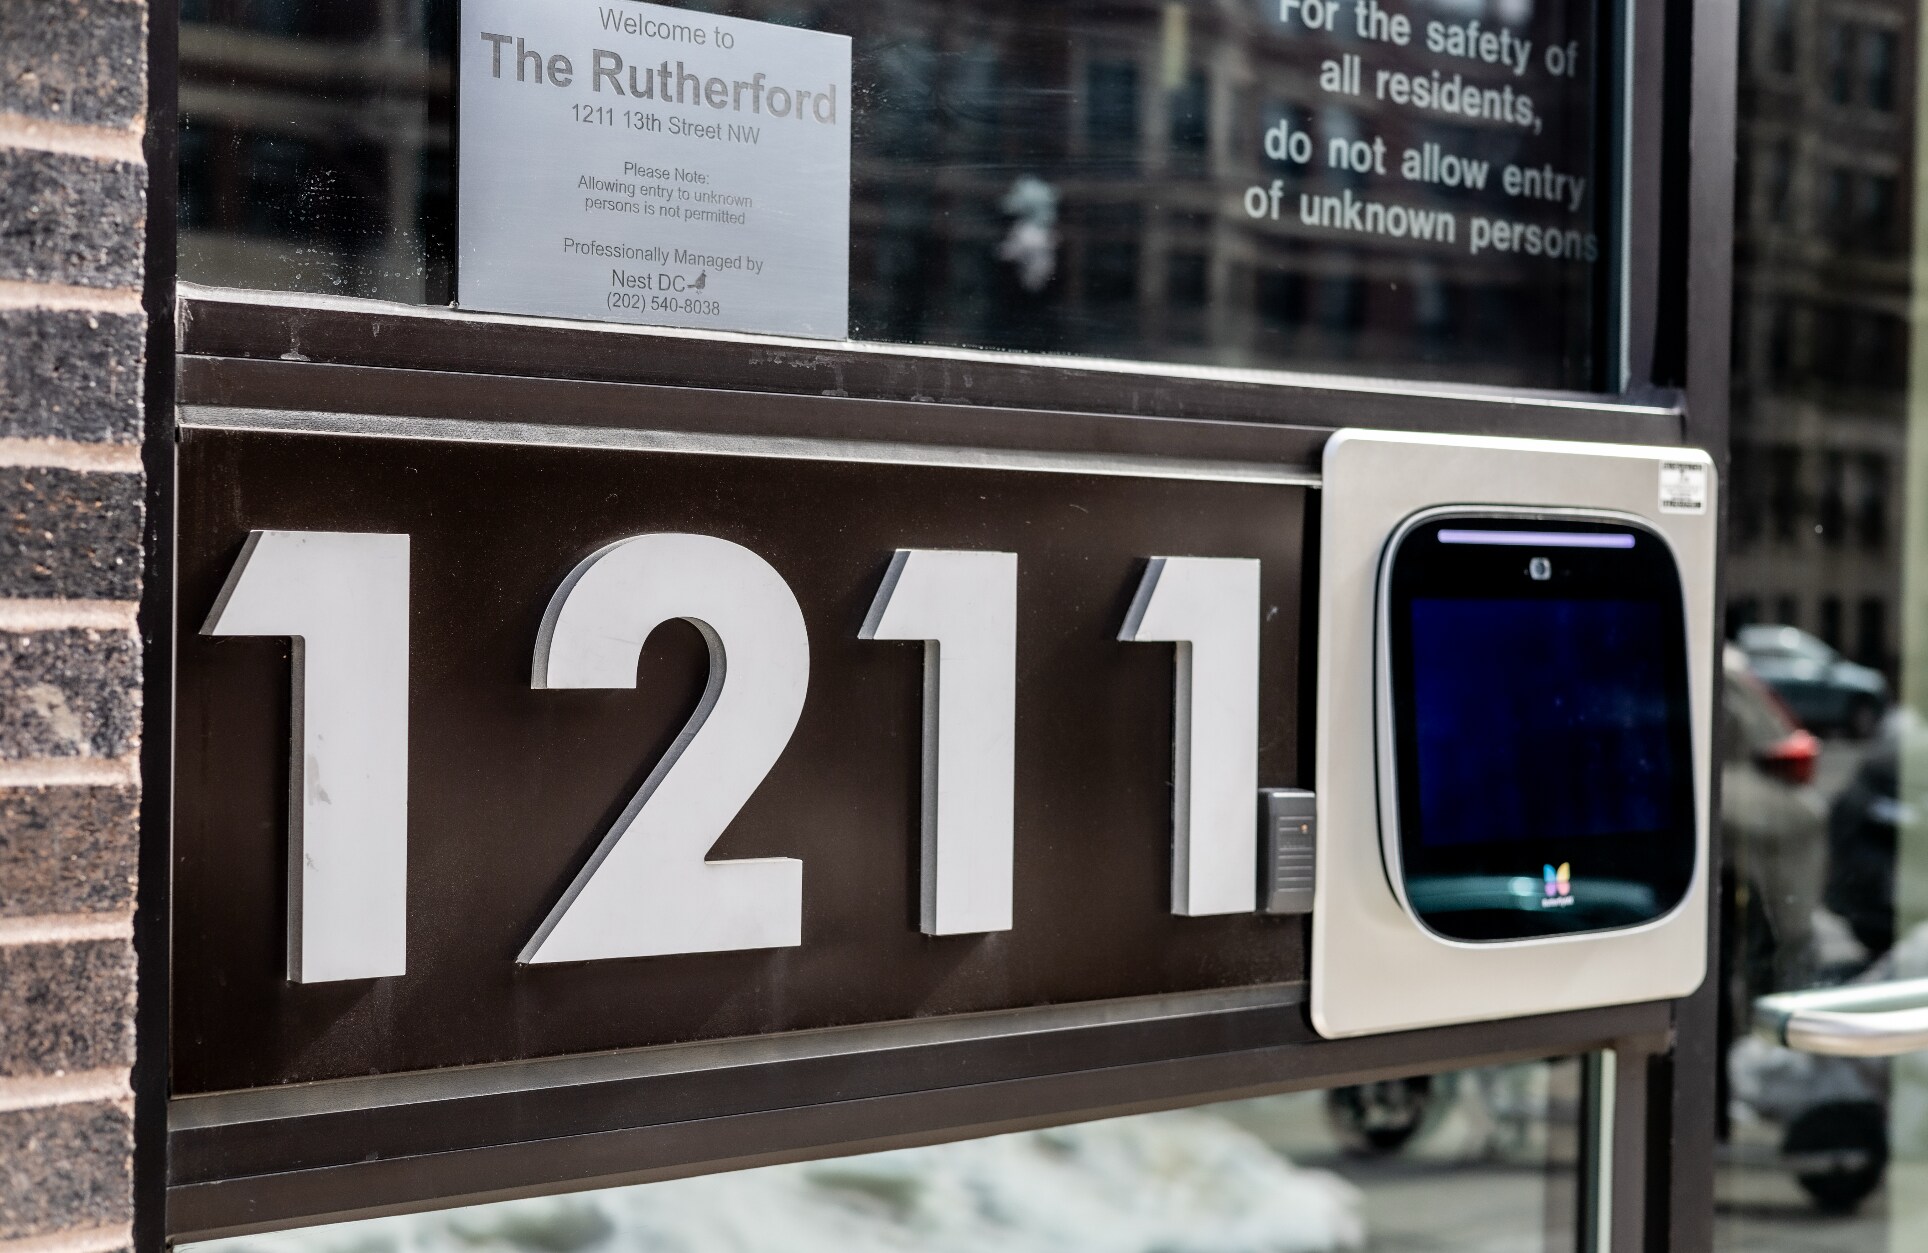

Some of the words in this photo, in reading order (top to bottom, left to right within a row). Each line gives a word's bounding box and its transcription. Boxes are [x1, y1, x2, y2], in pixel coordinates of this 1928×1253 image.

[599, 7, 706, 45] Welcome
[716, 26, 735, 50] to
[1354, 0, 1411, 46] the
[1426, 20, 1532, 76] safety
[1545, 41, 1579, 76] of
[480, 32, 573, 88] The
[592, 49, 837, 125] Rutherford
[1320, 54, 1361, 96] all
[1376, 69, 1543, 134] residents,
[572, 104, 613, 127] 1211
[624, 110, 661, 133] 13th
[668, 117, 722, 141] Street
[728, 125, 760, 145] NW
[624, 161, 670, 182] Please
[675, 168, 710, 185] Note:
[1264, 119, 1312, 164] do
[1328, 136, 1387, 174] not
[1402, 142, 1489, 190] allow
[1502, 163, 1586, 211] entry
[578, 175, 635, 198] Allowing
[640, 184, 673, 202] entry
[678, 186, 690, 201] to
[694, 189, 753, 208] unknown
[585, 197, 640, 215] persons
[644, 201, 655, 216] is
[660, 204, 681, 219] not
[684, 206, 746, 226] permitted
[1244, 179, 1284, 220] of
[1300, 188, 1456, 244] unknown
[1470, 216, 1599, 262] persons
[564, 237, 670, 267] Professionally
[674, 249, 742, 272] Managed
[747, 256, 764, 275] by
[612, 269, 653, 291] Nest
[658, 273, 686, 293] DC
[606, 291, 646, 314] (202)
[651, 296, 721, 317] 540-8038
[200, 529, 1261, 984] 1211
